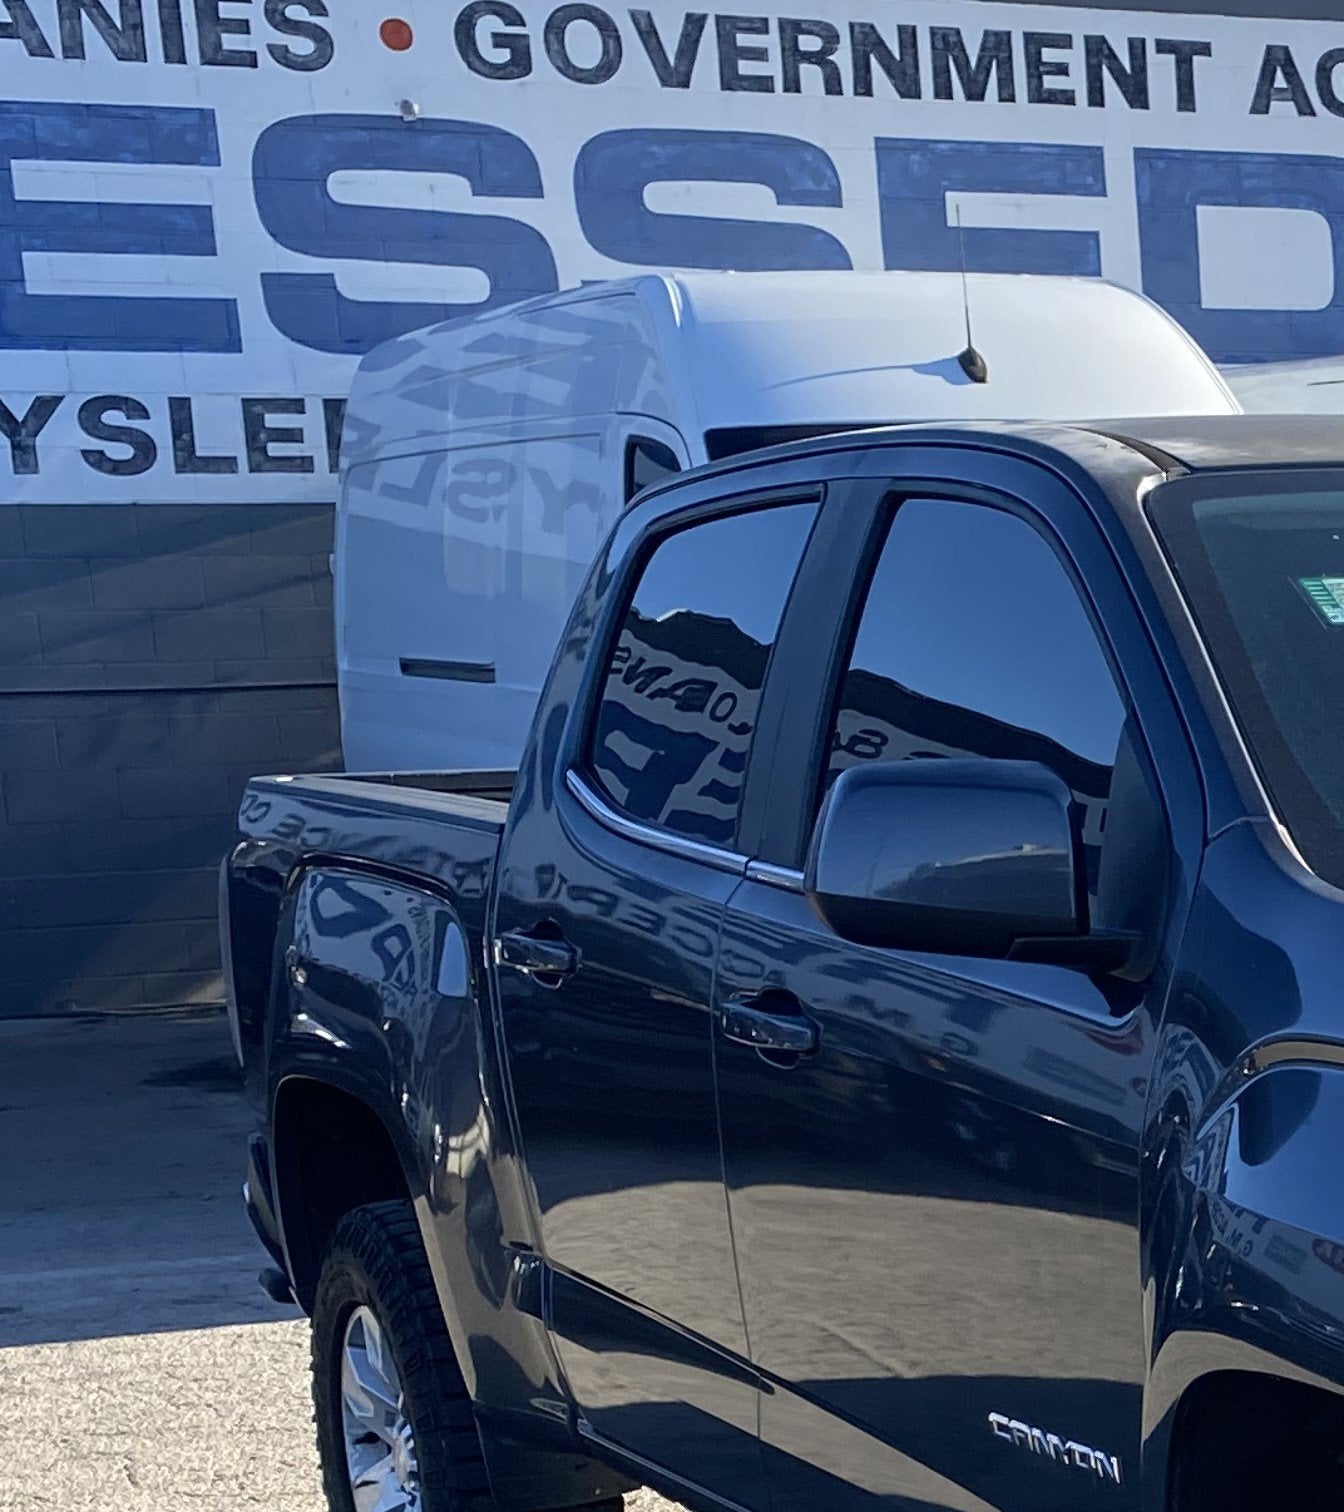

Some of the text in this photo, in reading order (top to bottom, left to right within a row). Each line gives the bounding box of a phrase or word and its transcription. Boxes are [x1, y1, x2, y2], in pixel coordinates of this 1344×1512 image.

[454, 0, 1212, 113] GOVERNMENT
[0, 394, 347, 476] YSLE
[988, 1412, 1121, 1484] CANYON
